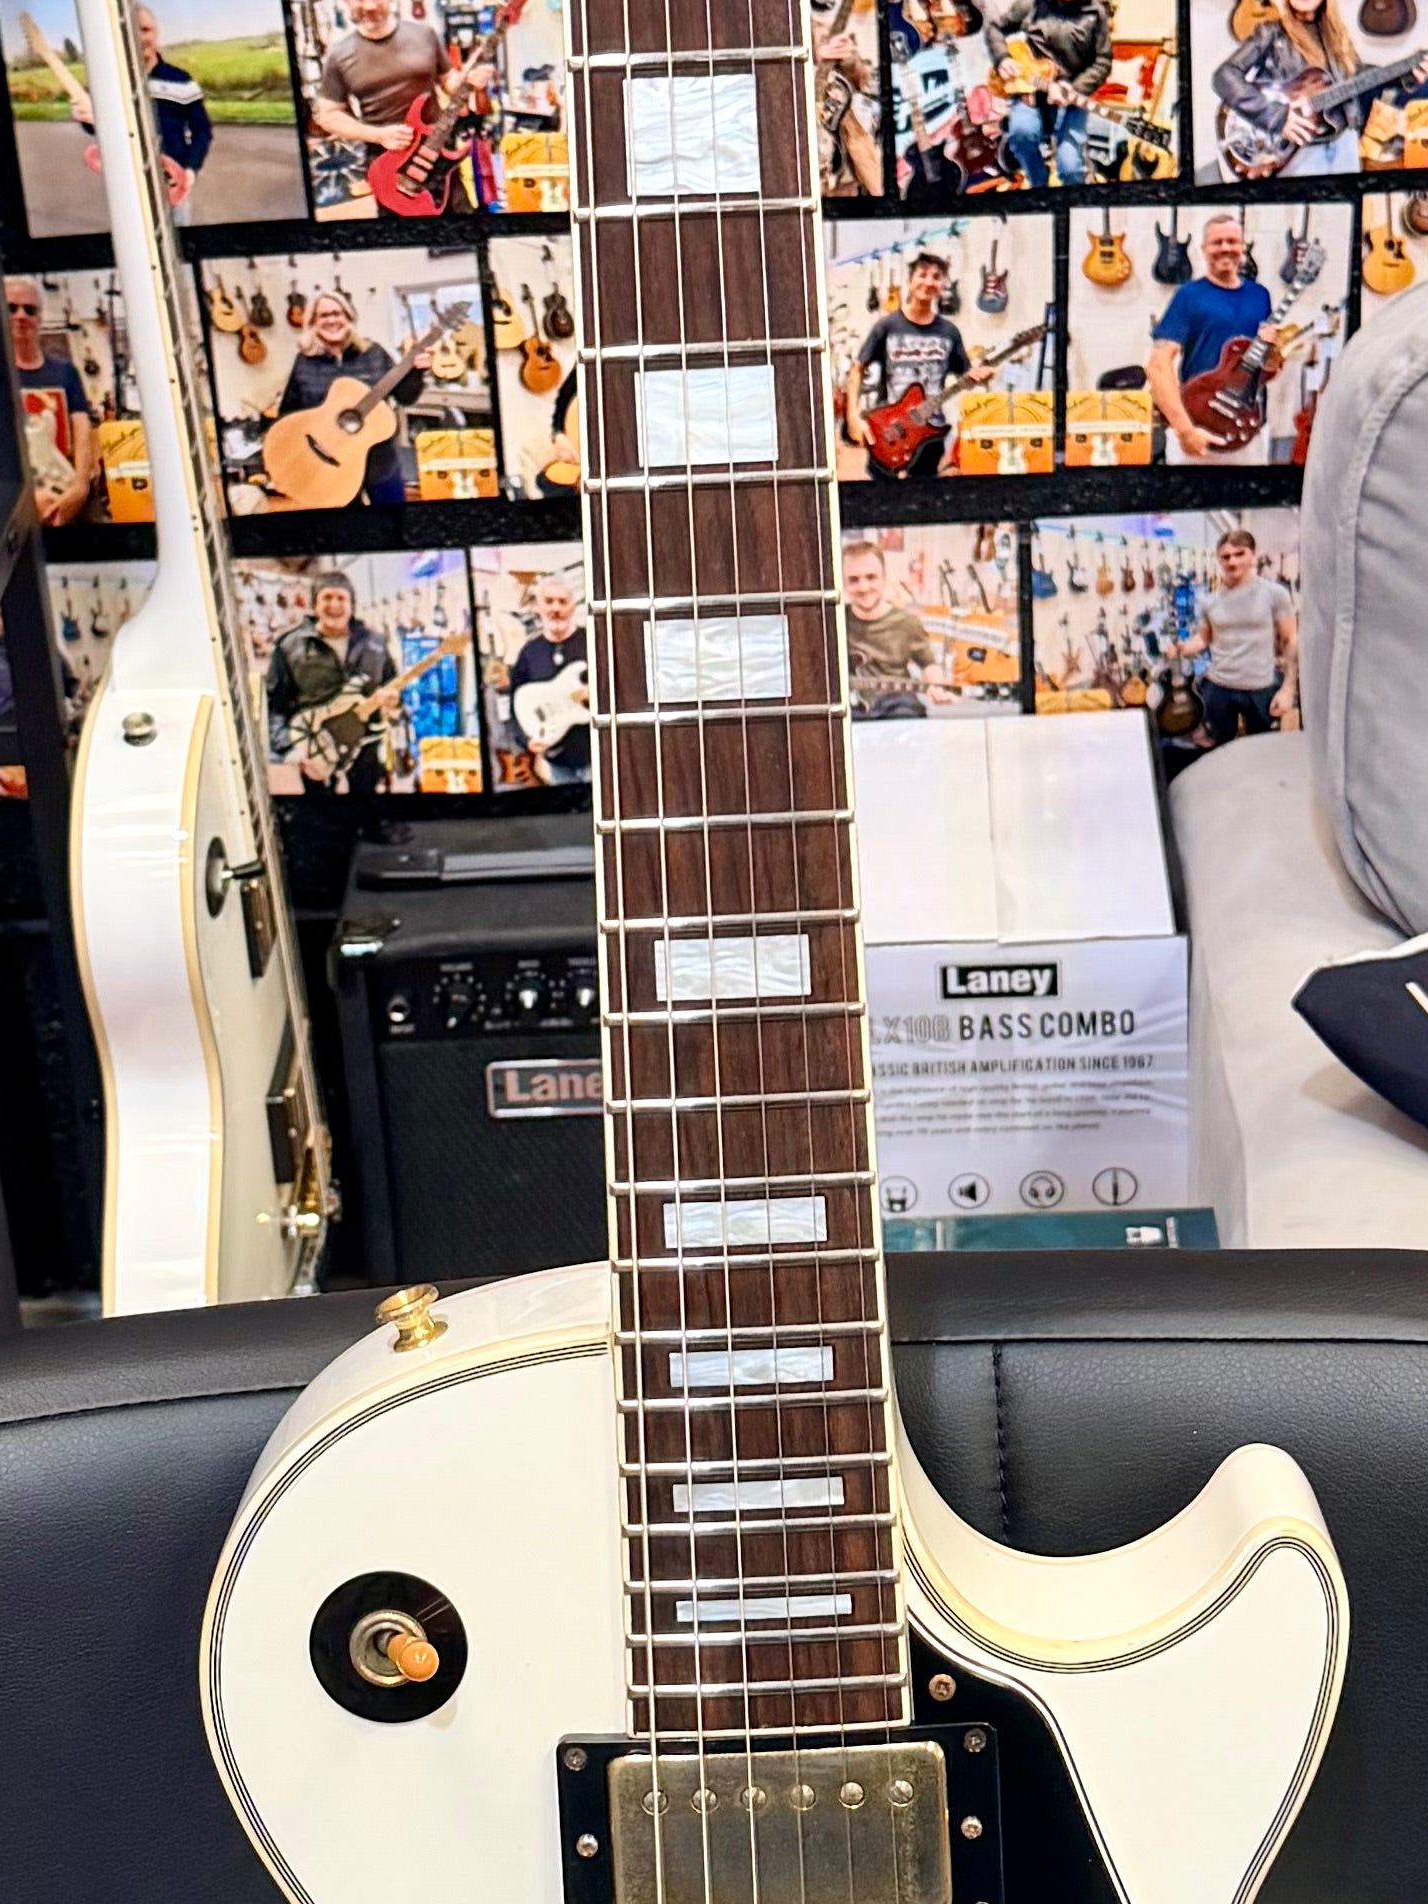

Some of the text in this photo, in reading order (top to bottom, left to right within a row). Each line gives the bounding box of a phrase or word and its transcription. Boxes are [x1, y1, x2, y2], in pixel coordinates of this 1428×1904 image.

[946, 966, 1054, 996] Laney
[958, 1012, 1034, 1041] BASS
[1040, 1008, 1136, 1038] COMBO
[911, 1060, 967, 1075] BRITISH
[968, 1056, 1076, 1074] AMPLIFICATION
[1078, 1055, 1120, 1072] SINCE
